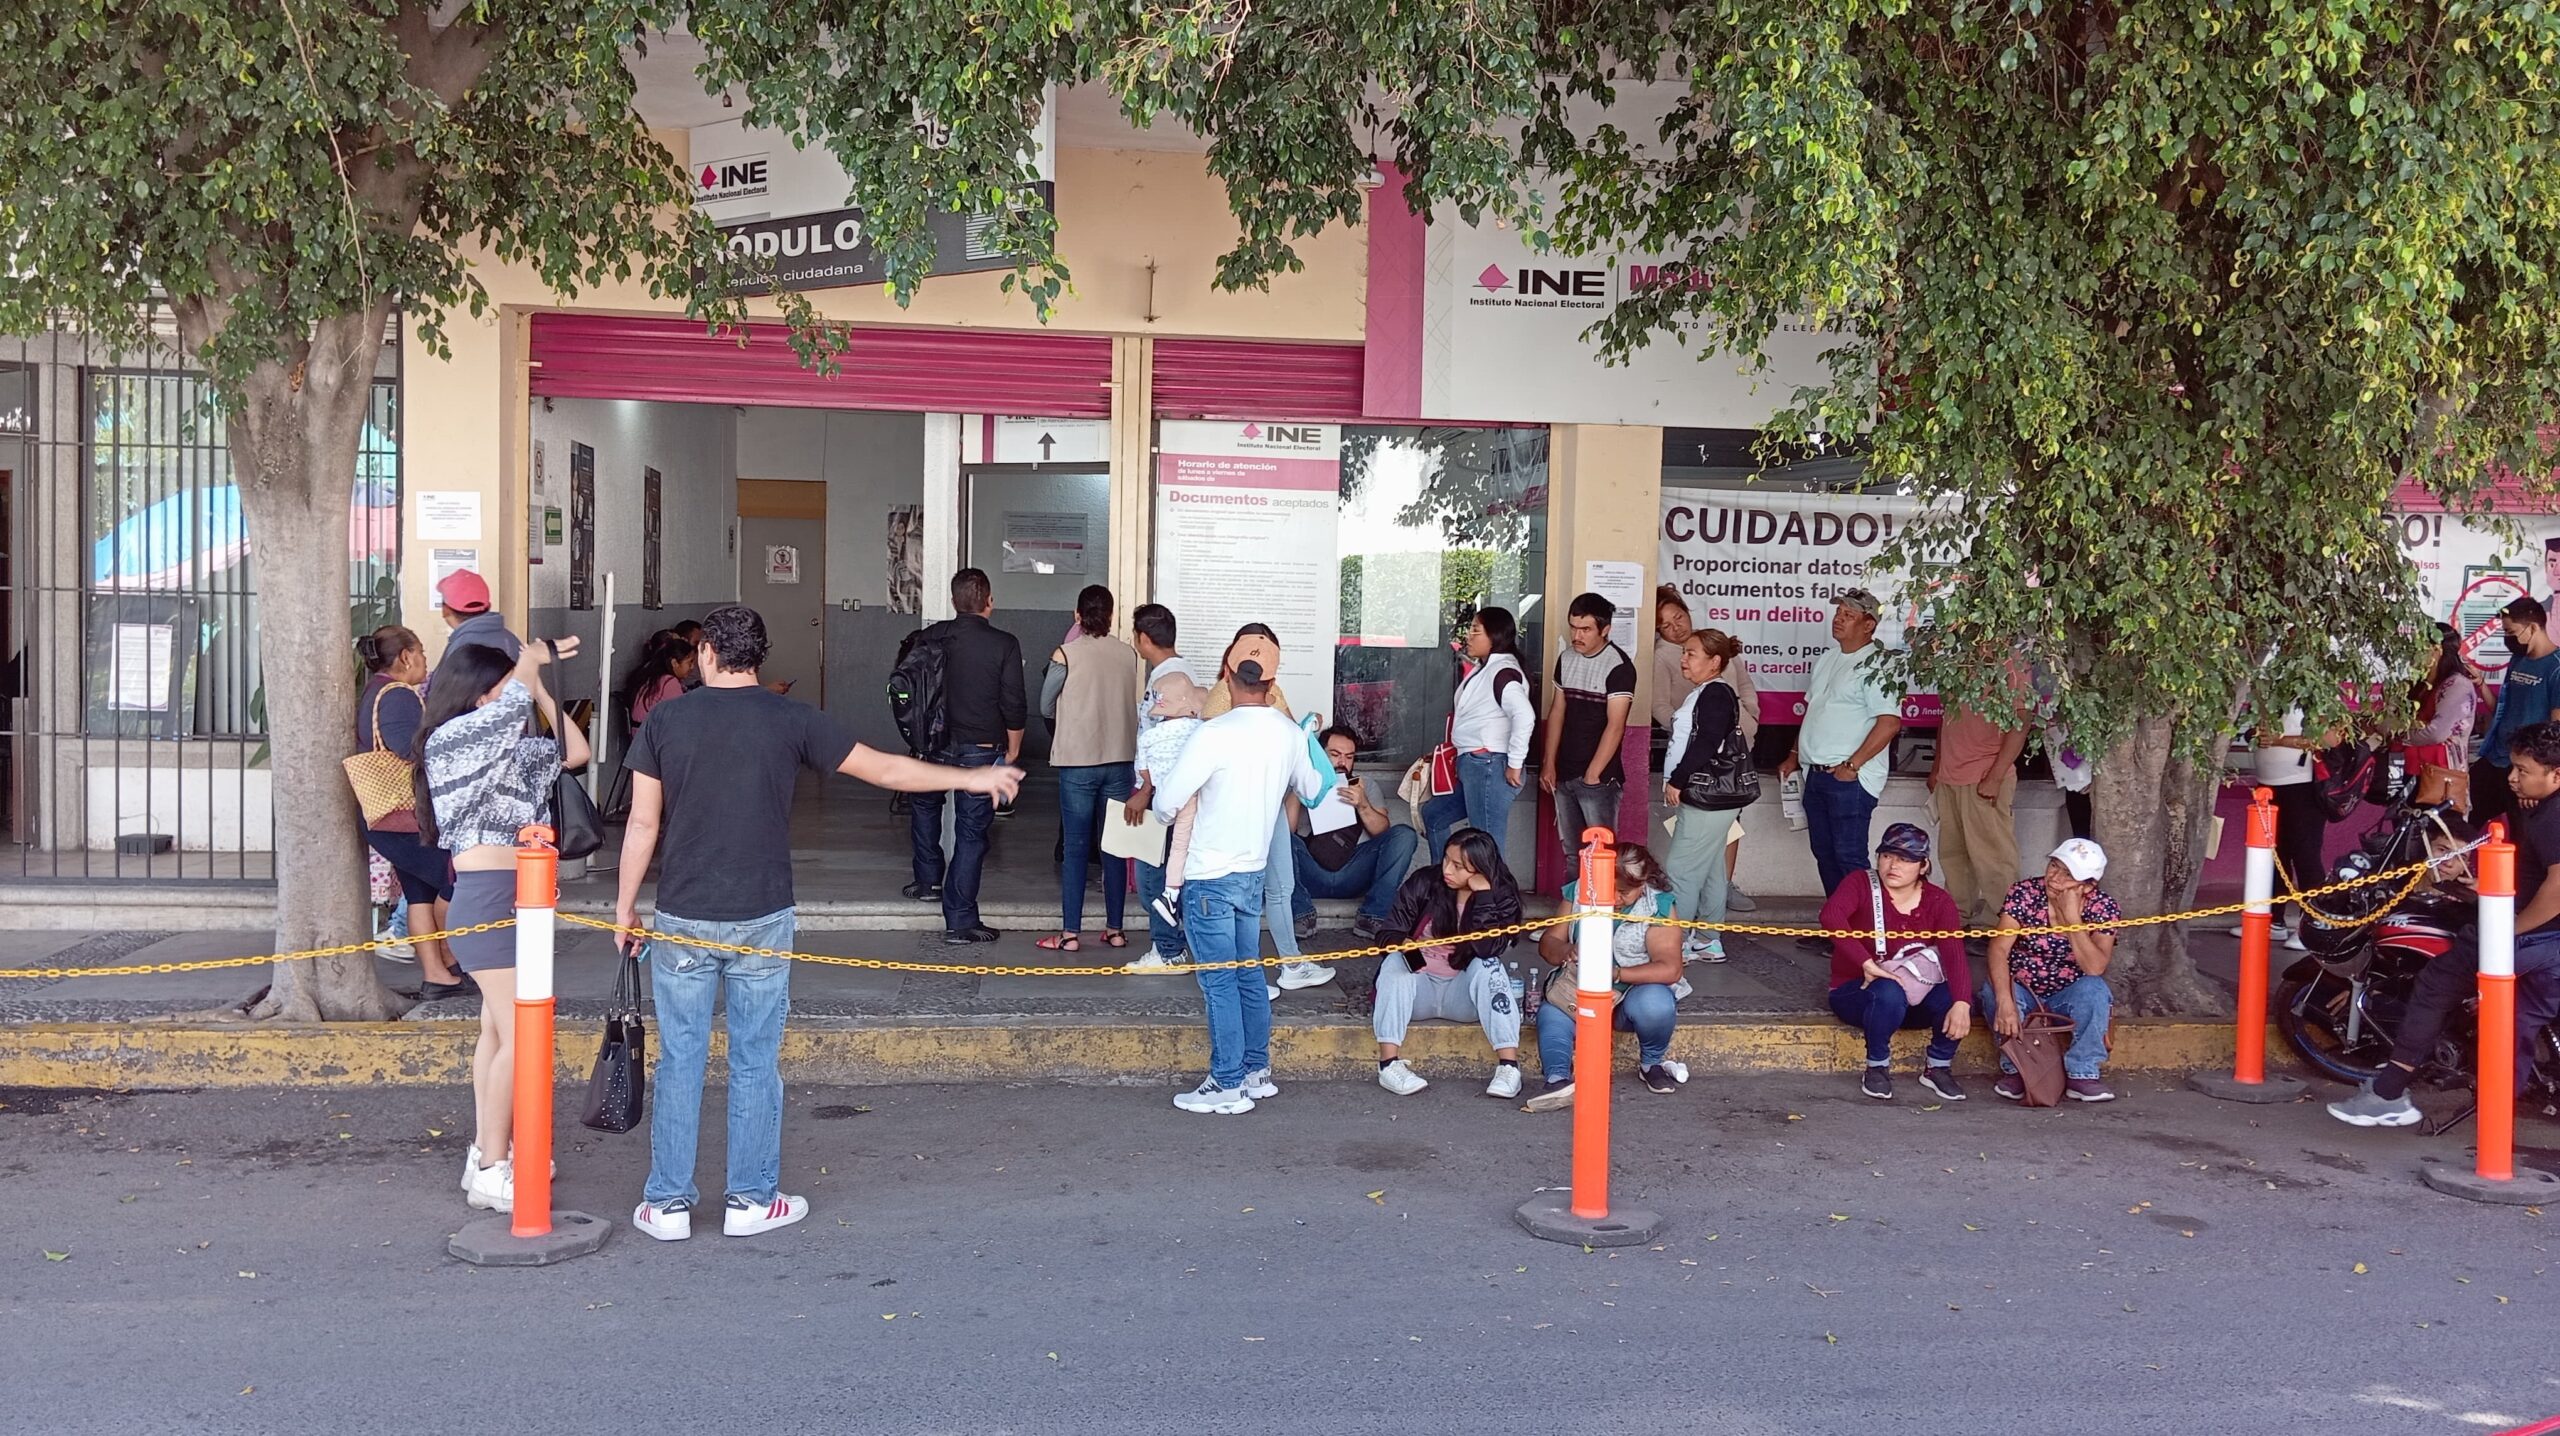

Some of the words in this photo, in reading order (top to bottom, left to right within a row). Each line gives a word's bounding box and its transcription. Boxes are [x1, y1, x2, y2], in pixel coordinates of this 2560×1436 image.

[721, 160, 767, 189] INE
[696, 192, 717, 204] Instituto
[718, 189, 742, 201] Nacional
[743, 184, 768, 198] Electoral
[783, 263, 864, 283] ciudadana
[1518, 269, 1605, 296] INE
[1470, 297, 1512, 308] Instituto
[1514, 298, 1558, 309] Nacional
[1560, 300, 1605, 310] Electoral
[1268, 426, 1321, 443] INE
[1178, 459, 1216, 469] Horario
[1218, 461, 1230, 469] de
[1233, 462, 1277, 472] atención
[1169, 490, 1268, 506] Documentos
[1272, 499, 1329, 509] aceptados
[1659, 506, 1893, 547] CUIDADO!
[1673, 554, 1802, 576] Proporcionar
[1808, 558, 1863, 576] datos
[1683, 579, 1804, 599] documentos
[1709, 608, 1730, 621] es
[1736, 608, 1760, 621] un
[1766, 606, 1824, 623] delito
[2466, 619, 2502, 650] FALS
[1788, 645, 1798, 656] o
[1761, 661, 1812, 674] carcel!
